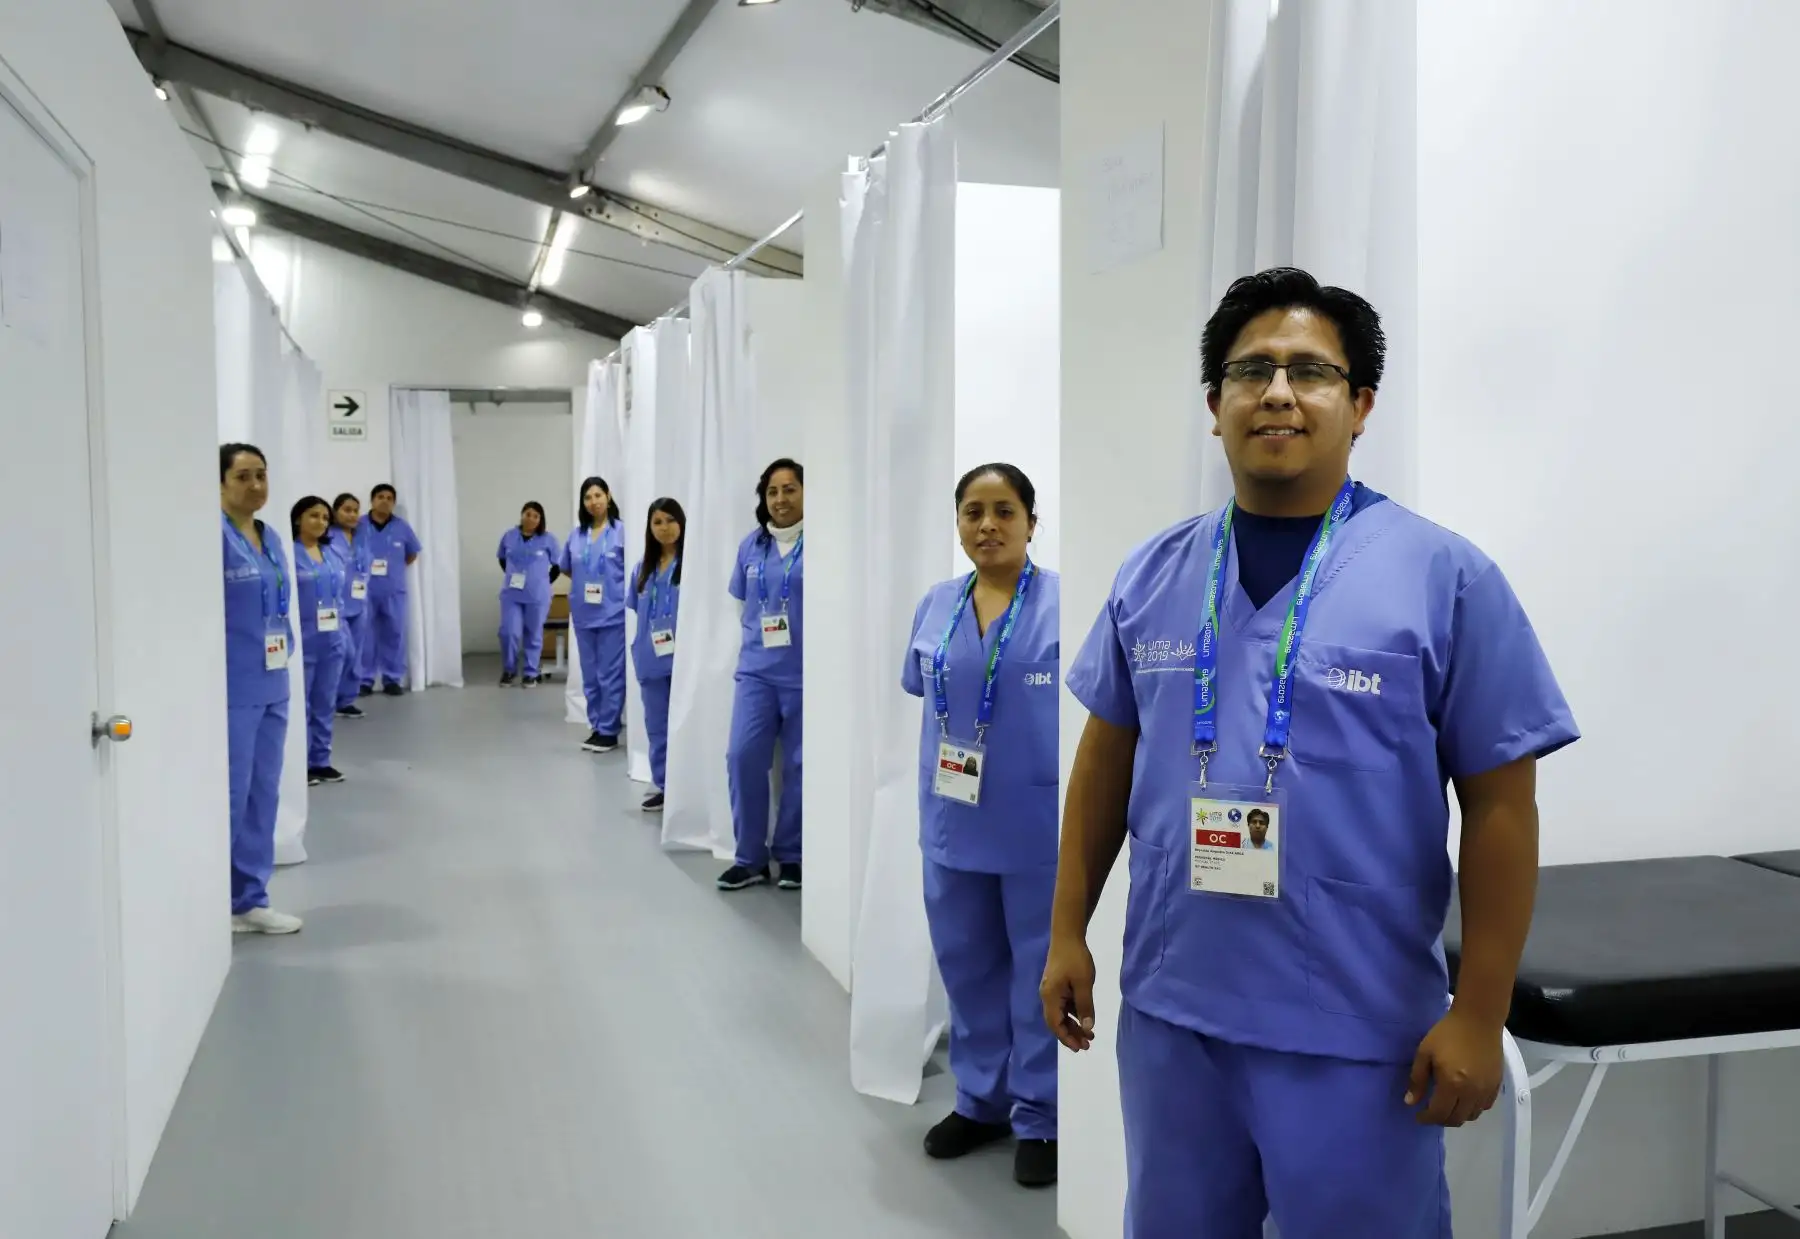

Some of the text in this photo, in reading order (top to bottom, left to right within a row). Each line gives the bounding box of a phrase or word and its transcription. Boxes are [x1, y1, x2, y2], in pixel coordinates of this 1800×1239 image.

[1147, 650, 1169, 662] 2019
[1346, 669, 1382, 695] ibt
[1209, 833, 1227, 844] OC
